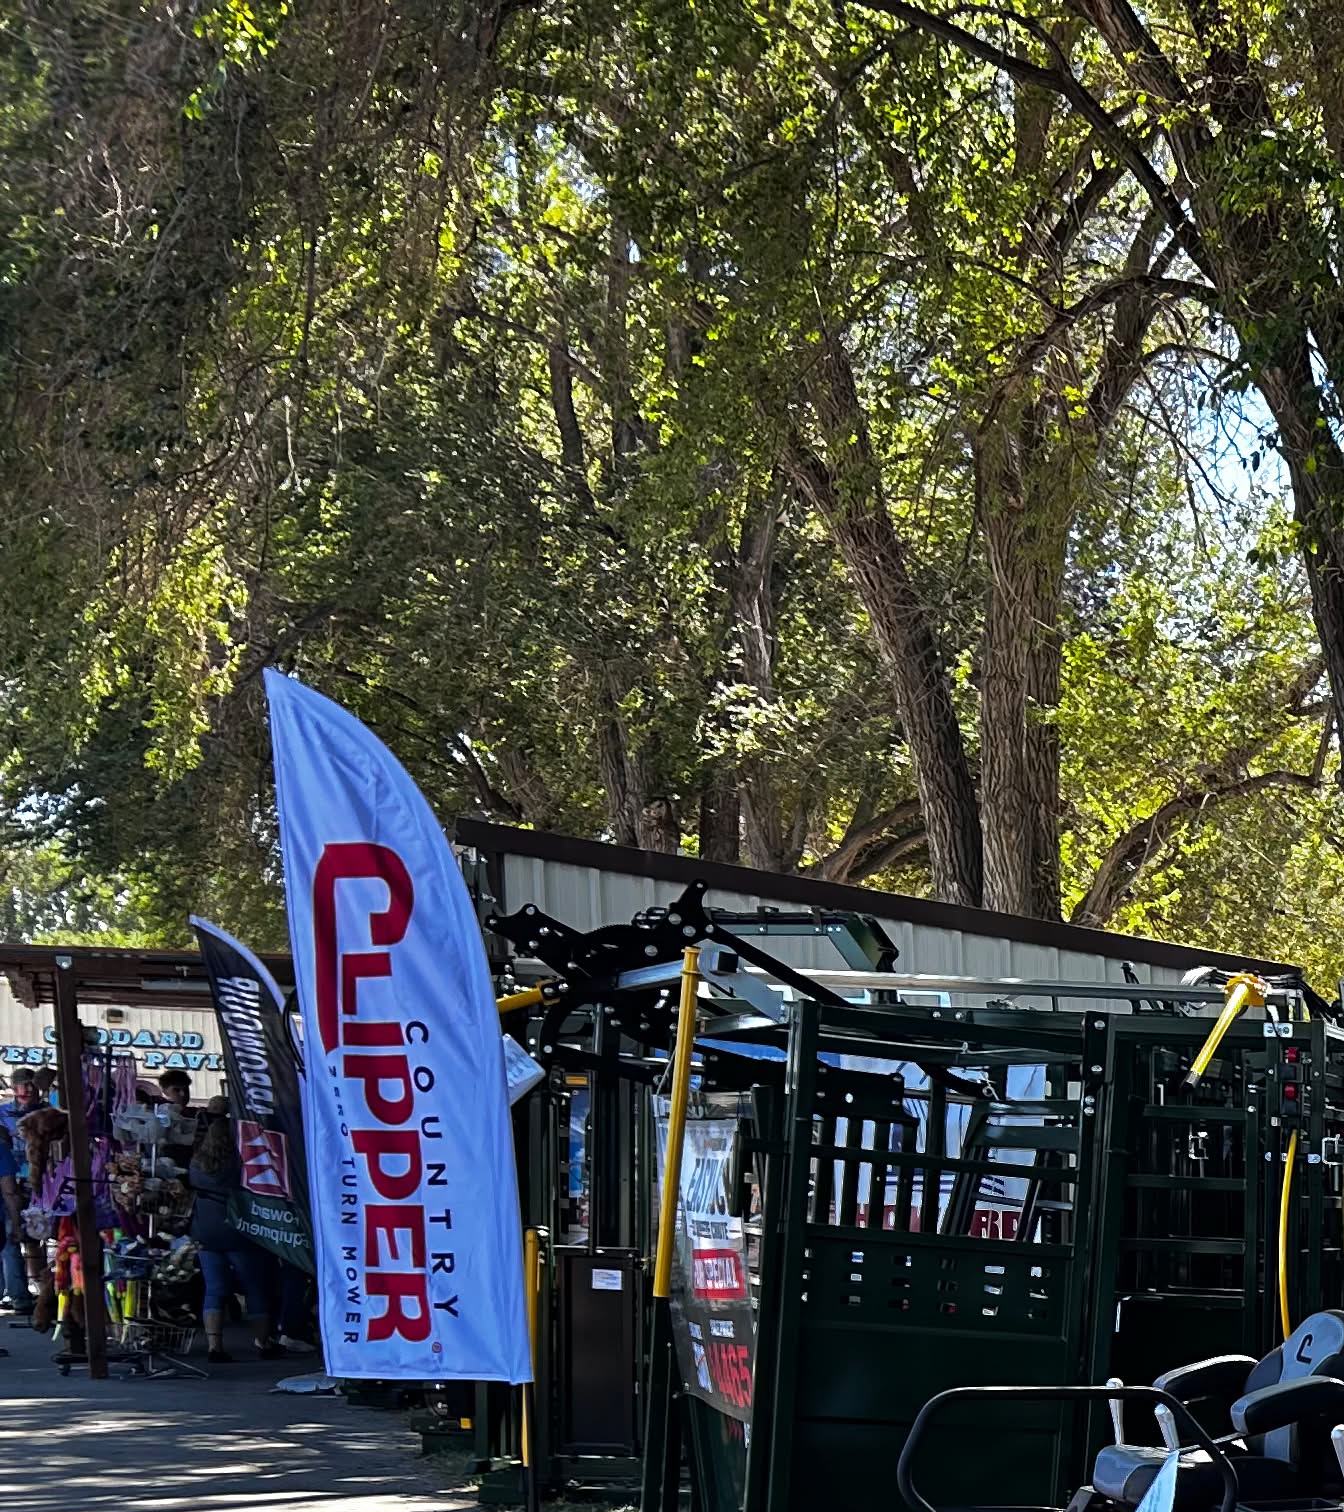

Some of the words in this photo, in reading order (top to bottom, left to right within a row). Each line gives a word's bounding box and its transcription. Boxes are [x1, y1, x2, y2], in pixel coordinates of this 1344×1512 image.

[312, 841, 433, 1344] CLIPPER
[341, 1157, 357, 1226] TURN
[406, 1020, 460, 1319] COUNTRY
[341, 1246, 362, 1345] MOWER
